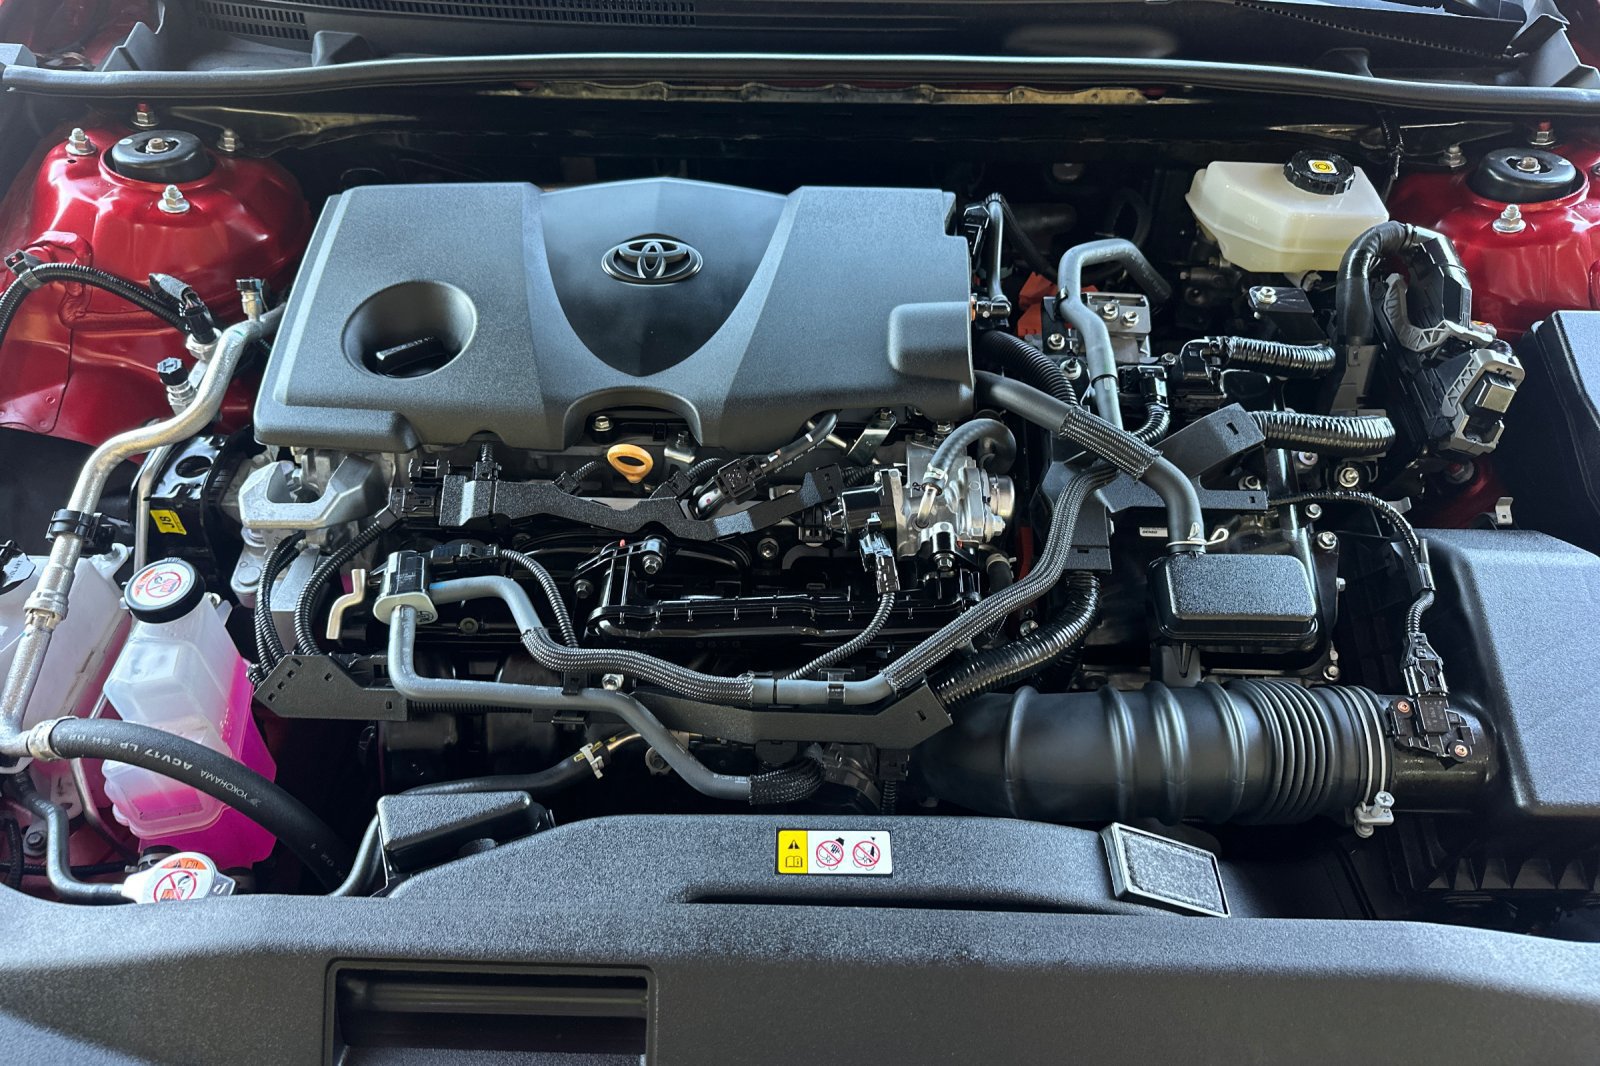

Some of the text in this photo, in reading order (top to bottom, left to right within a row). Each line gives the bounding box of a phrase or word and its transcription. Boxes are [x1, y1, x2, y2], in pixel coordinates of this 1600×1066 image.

[120, 742, 138, 752] LP
[144, 748, 193, 770] ACV17
[200, 769, 248, 800] YOKOHAMA
